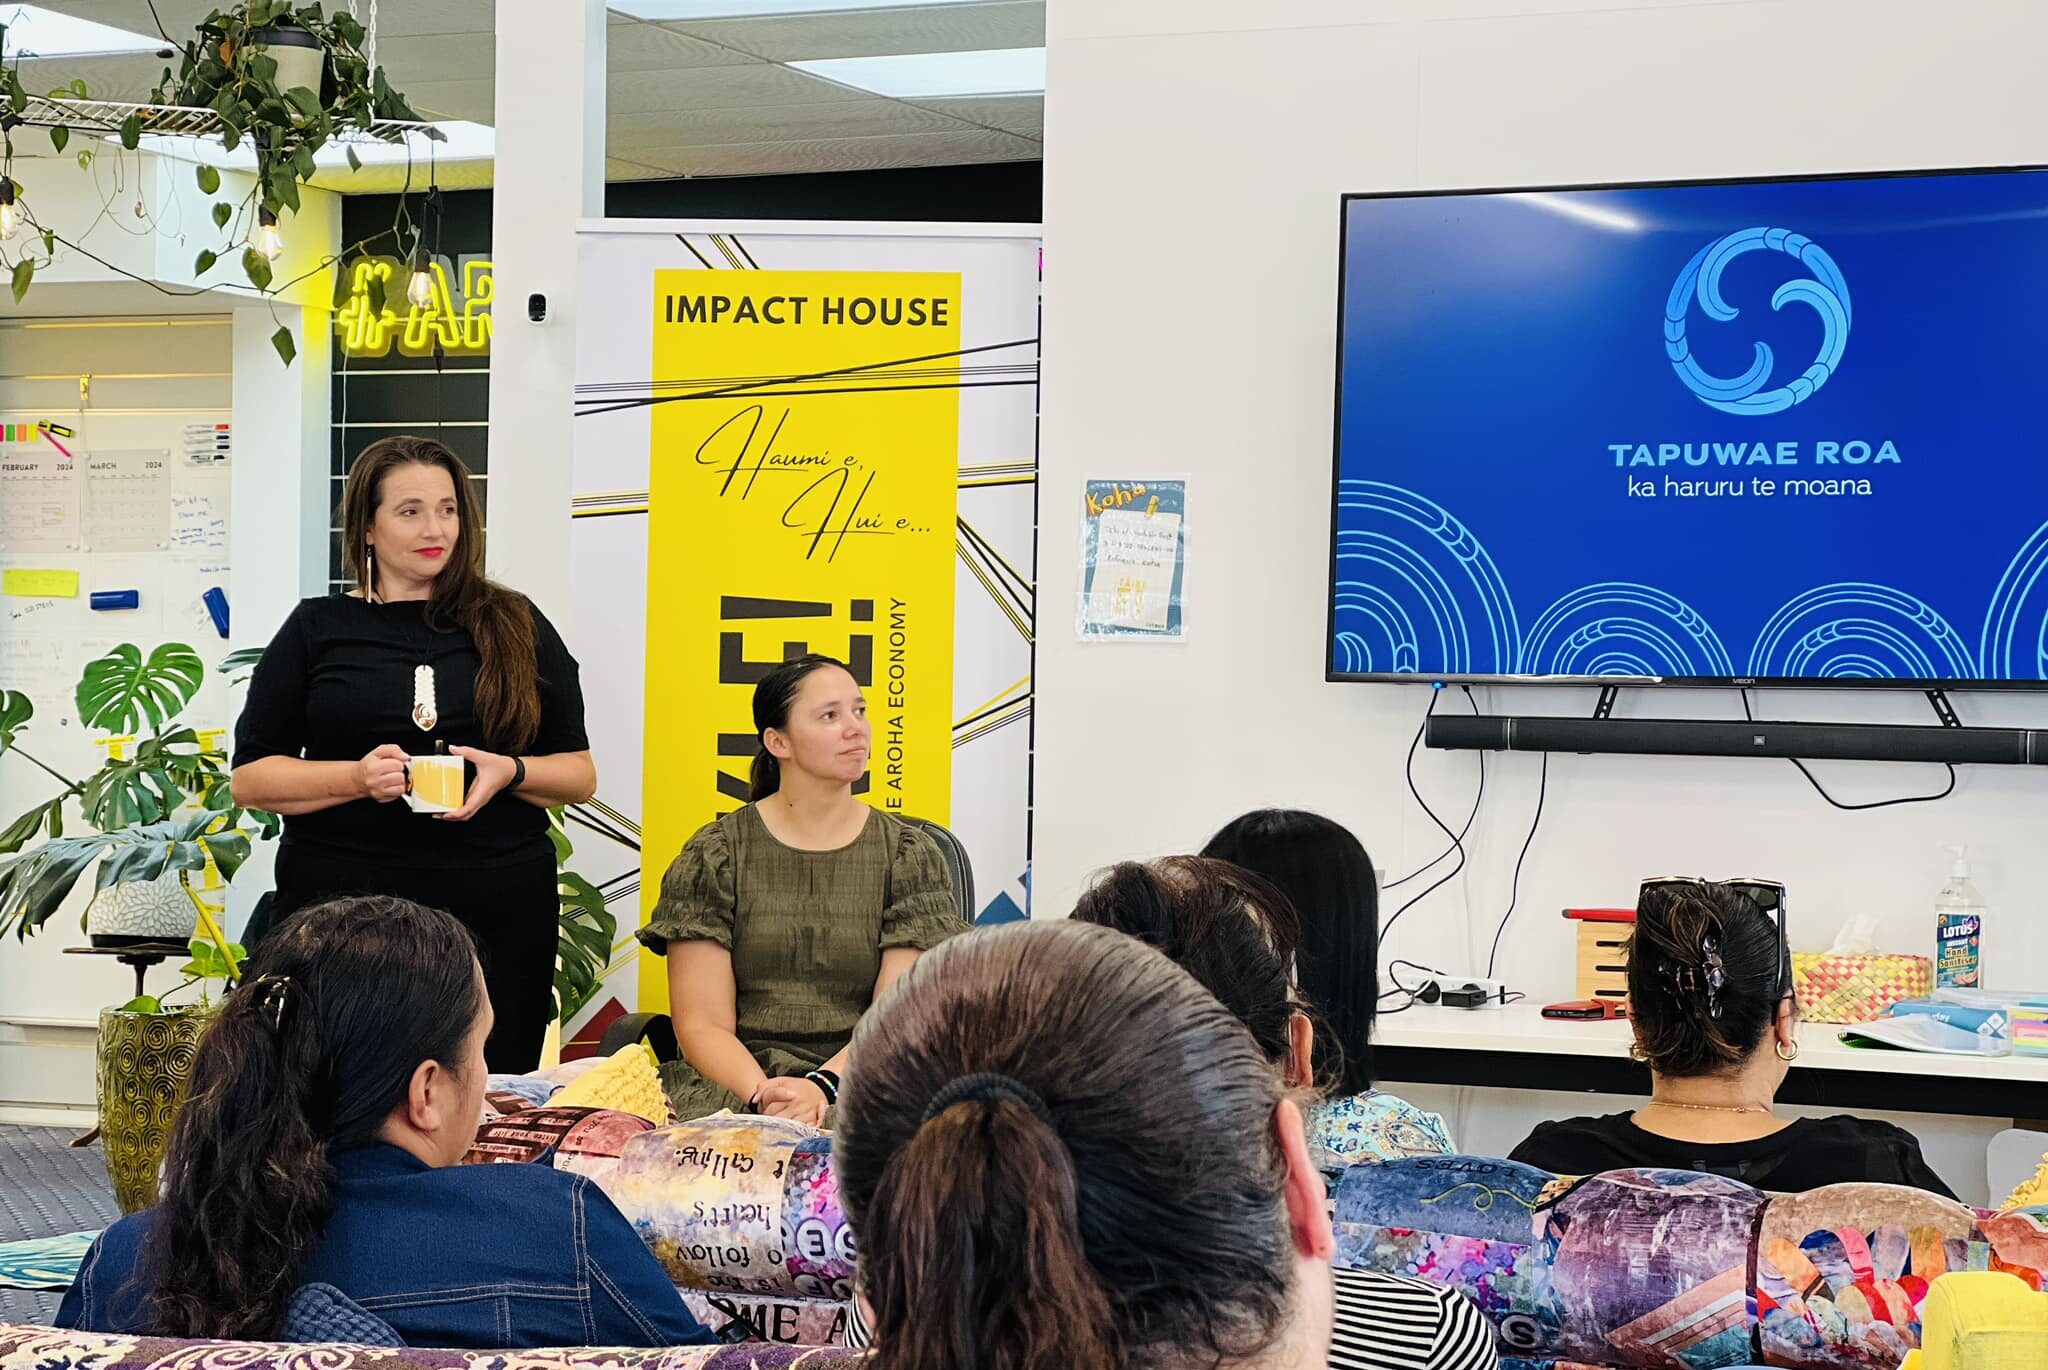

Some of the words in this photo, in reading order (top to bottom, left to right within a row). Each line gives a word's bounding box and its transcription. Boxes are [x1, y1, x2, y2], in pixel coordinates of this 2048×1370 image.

[665, 295, 808, 325] IMPACT
[822, 297, 948, 326] HOUSE
[695, 404, 831, 500] Haumi
[1608, 442, 1799, 466] TAPUWAE
[1816, 440, 1902, 464] ROA
[2, 463, 39, 471] FEBRUARY
[56, 463, 73, 471] 2024
[90, 462, 117, 470] MARCH
[145, 461, 162, 469] 2024
[1628, 474, 1657, 497] ka
[1664, 474, 1744, 497] haruru
[1752, 476, 1776, 496] te
[1784, 478, 1873, 496] moana
[781, 467, 896, 564] Hui
[888, 597, 907, 708] ECONOMY
[886, 715, 905, 791] AROHA
[1943, 924, 1974, 938] LOTUS
[1414, 1158, 1519, 1178] LOVES
[676, 1244, 751, 1268] follow
